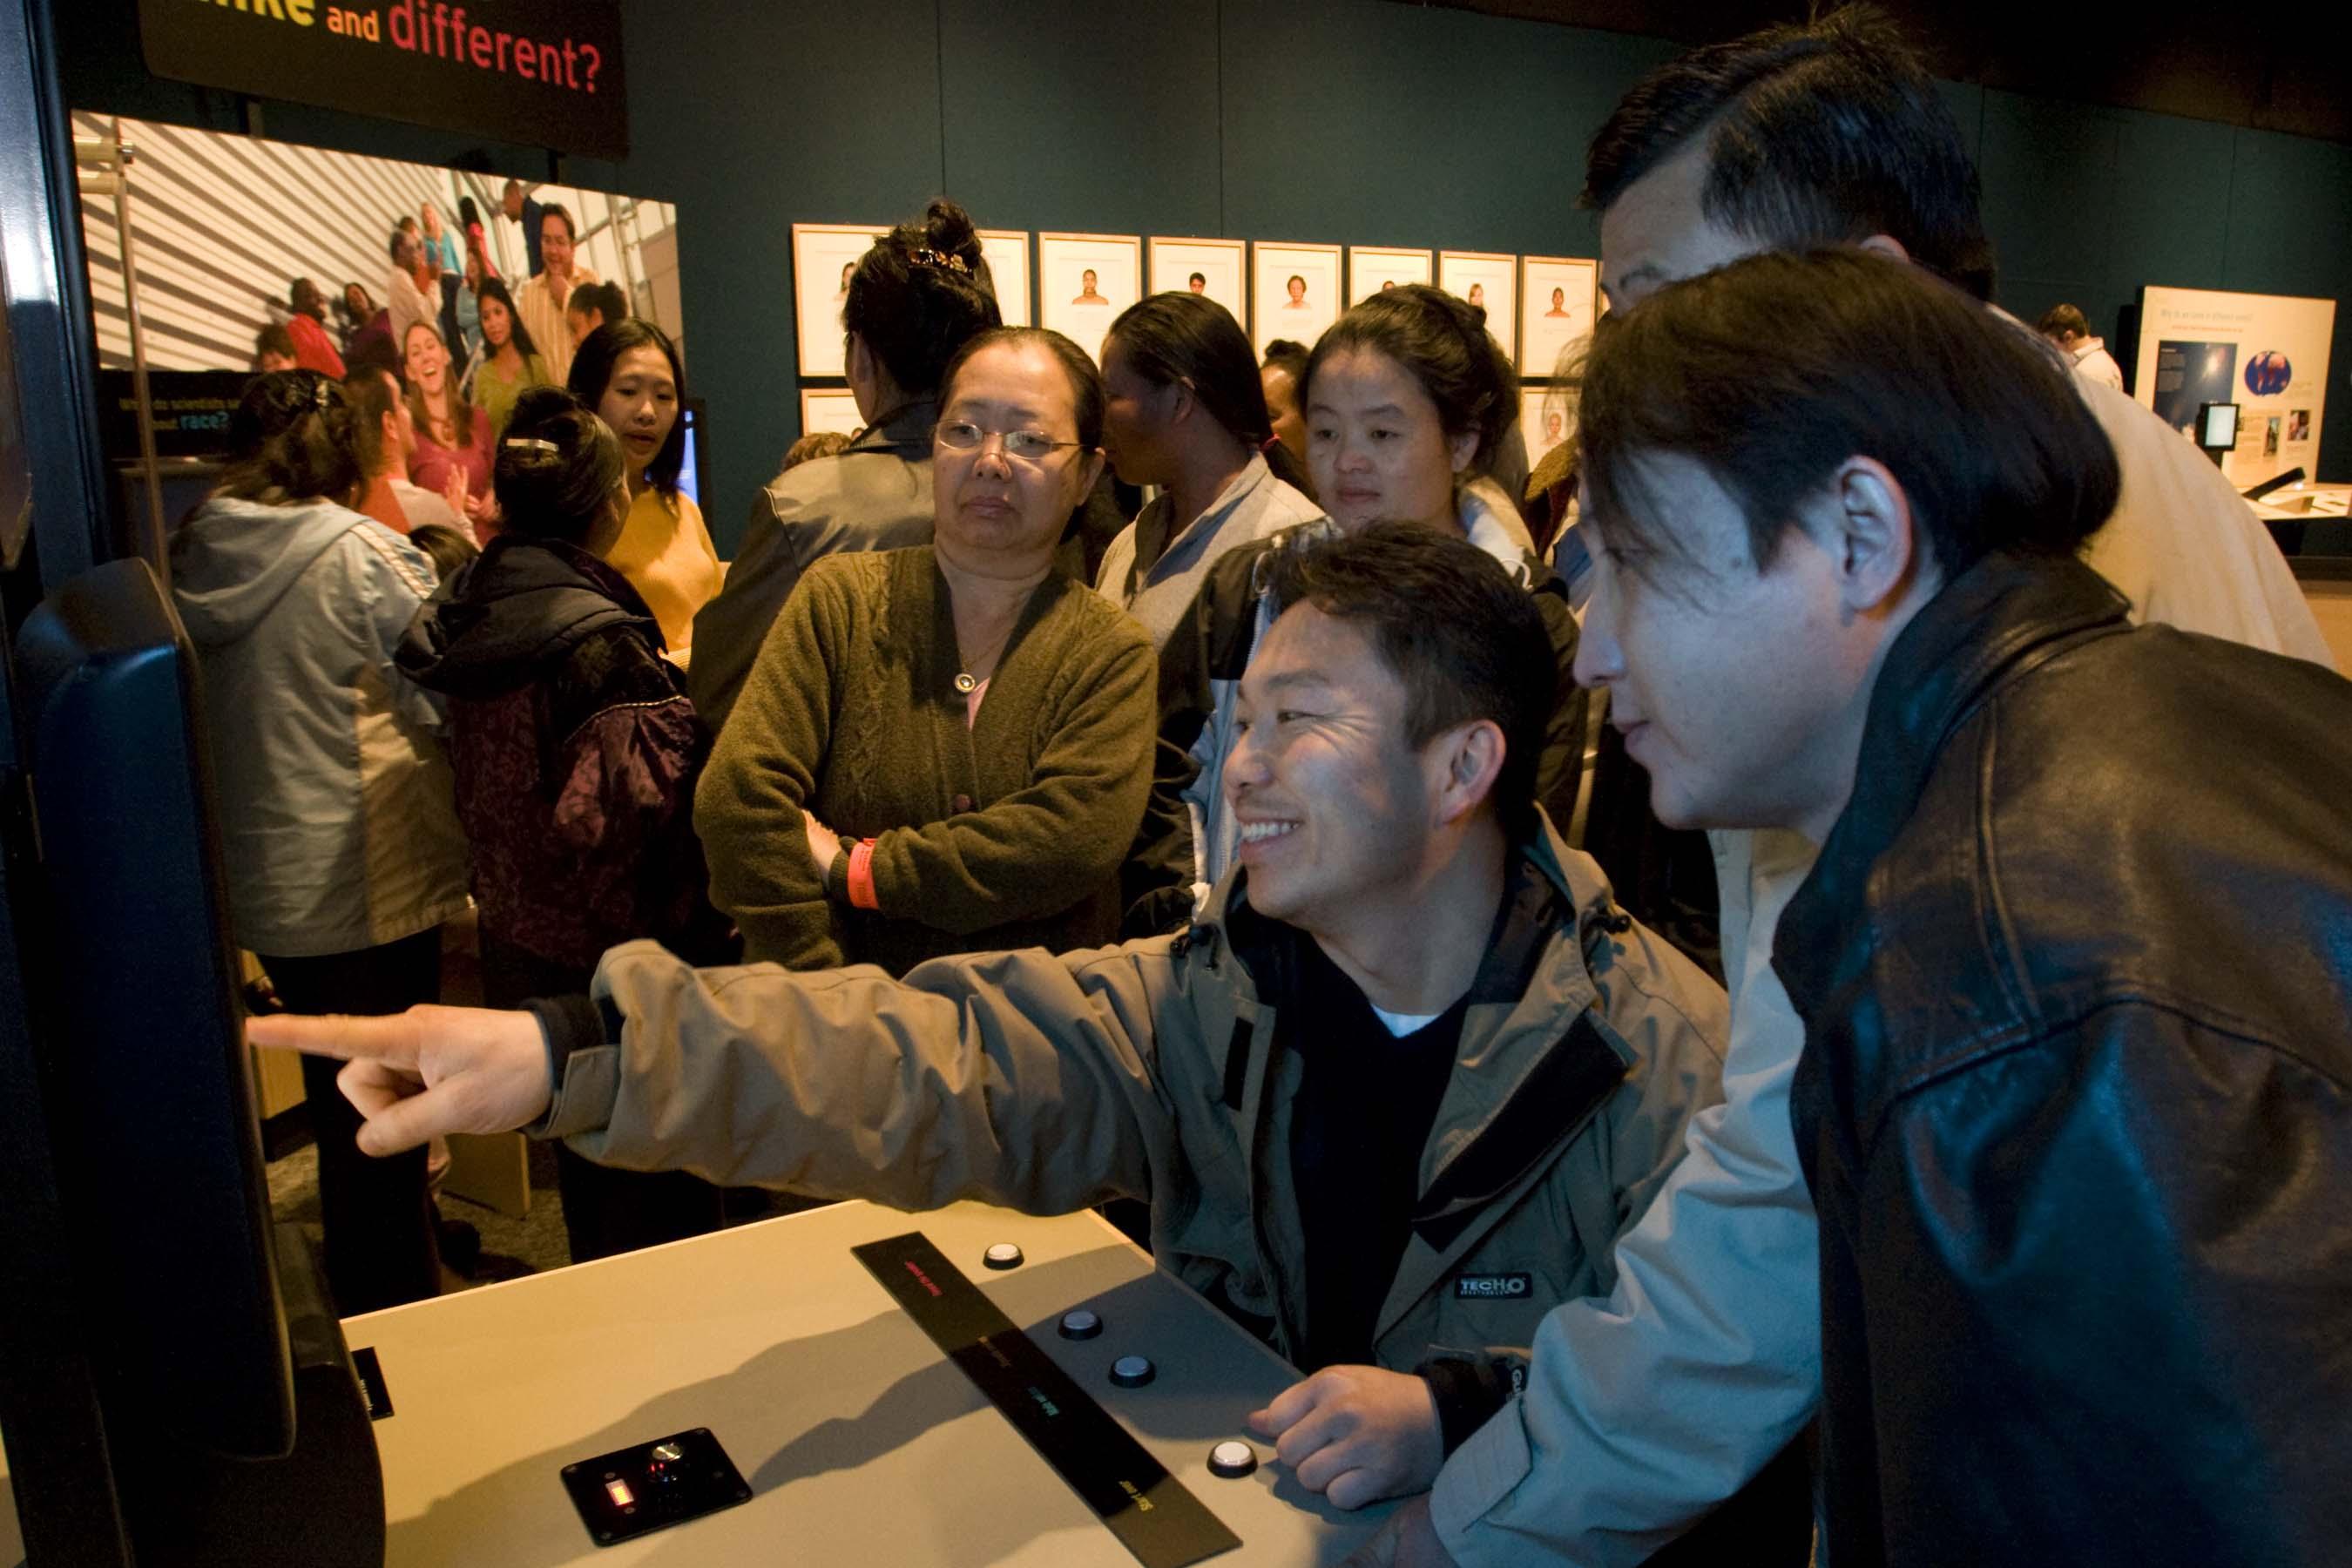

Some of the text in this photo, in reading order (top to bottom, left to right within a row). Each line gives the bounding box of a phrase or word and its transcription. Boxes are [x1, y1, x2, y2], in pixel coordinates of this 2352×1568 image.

[327, 6, 380, 42] and
[389, 0, 601, 92] different?
[181, 411, 229, 429] race?
